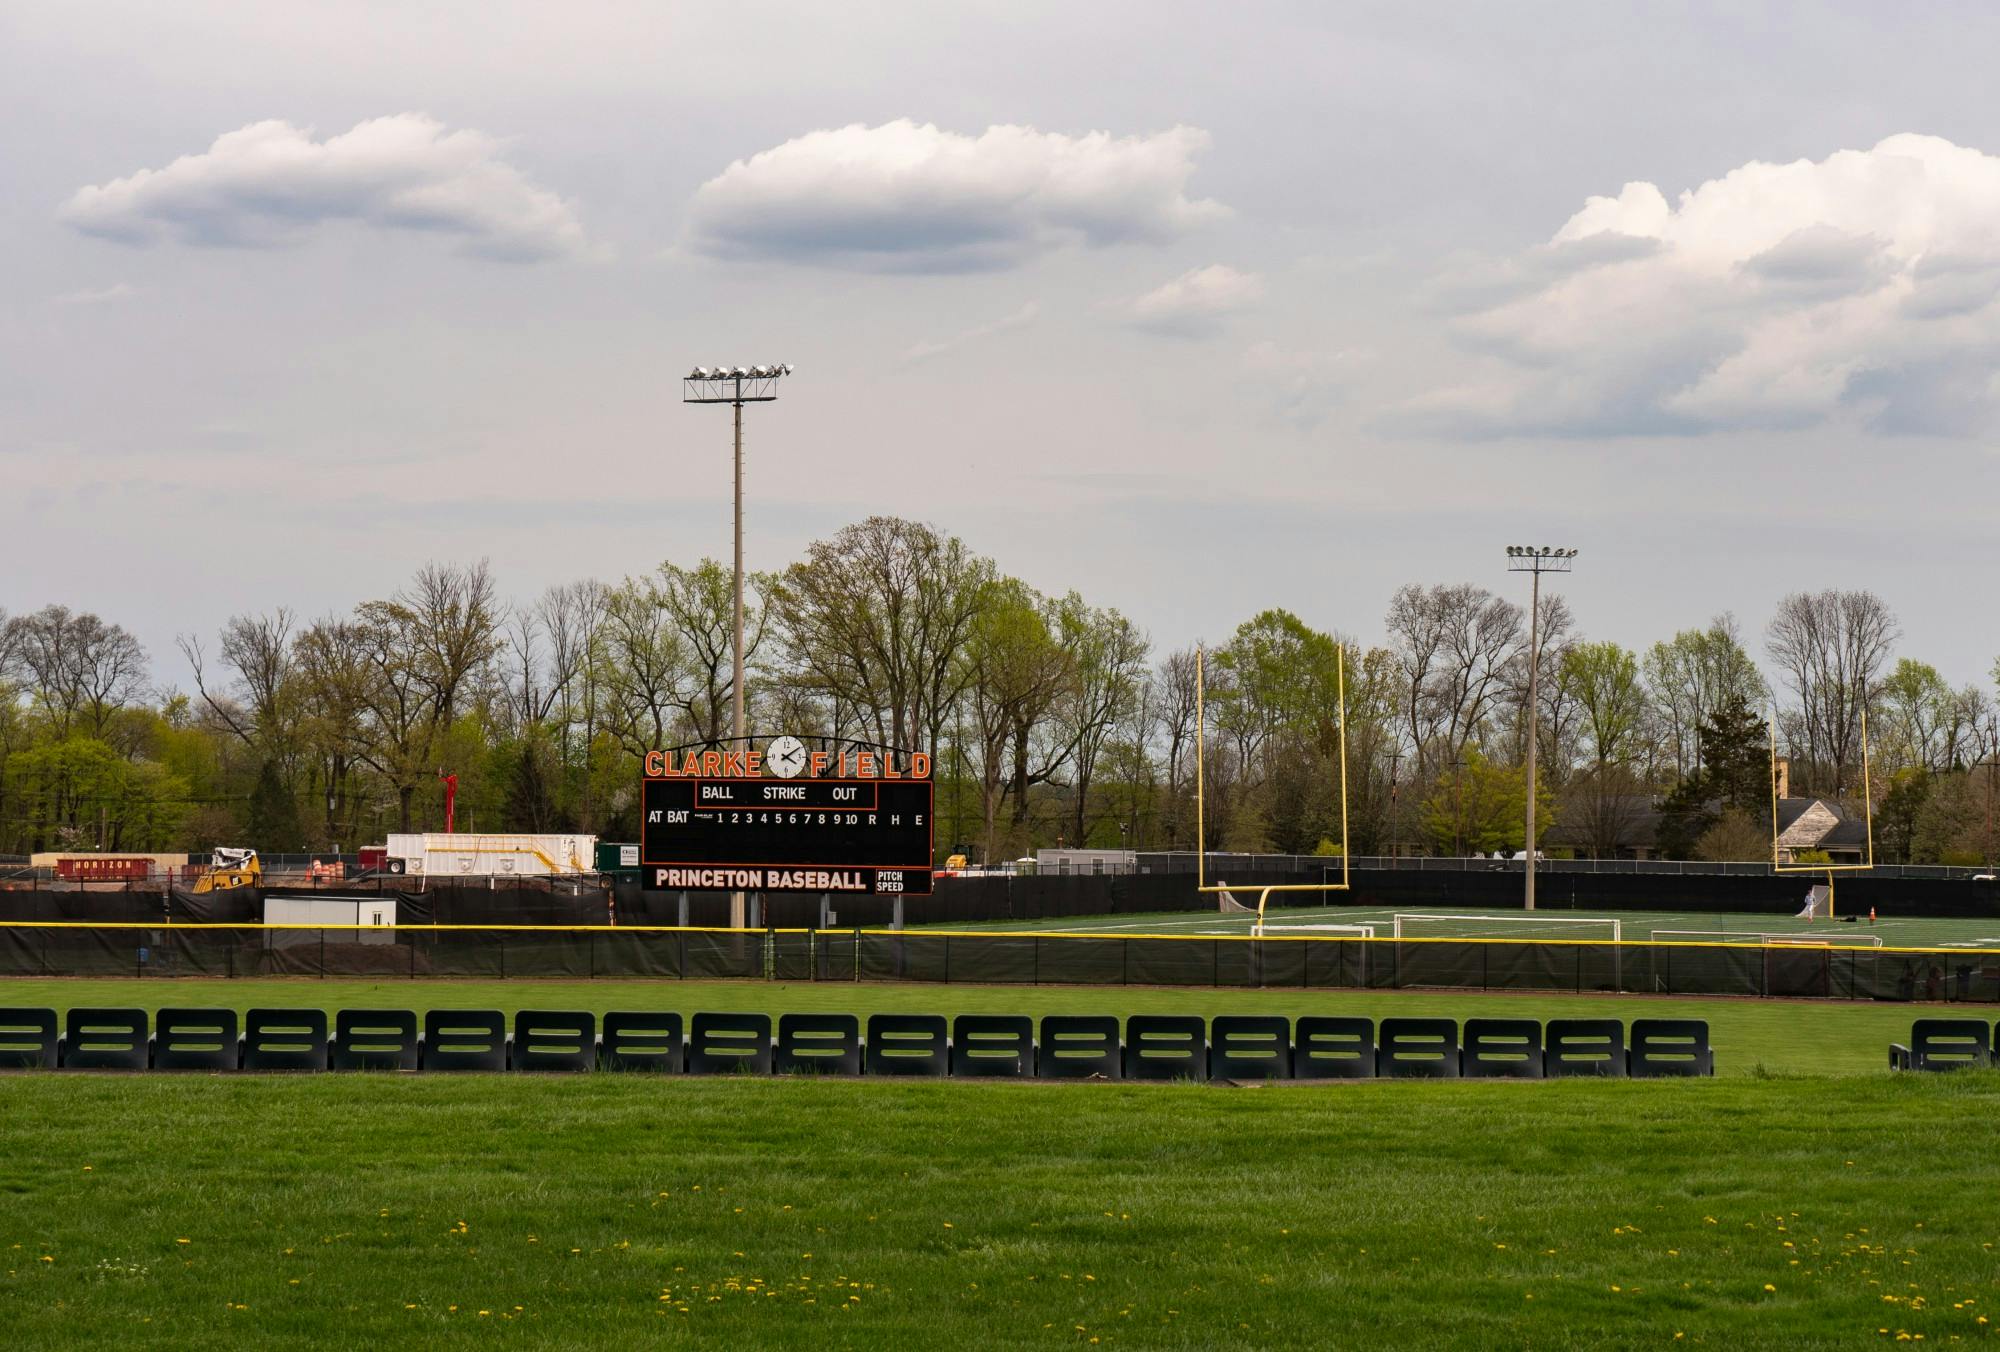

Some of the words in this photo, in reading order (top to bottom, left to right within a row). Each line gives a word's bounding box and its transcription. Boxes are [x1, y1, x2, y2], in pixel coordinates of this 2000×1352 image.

[783, 741, 791, 749] 12
[645, 750, 762, 777] CLARKE
[810, 751, 931, 778] FIELD
[702, 786, 734, 799] BALL
[763, 787, 806, 800] STRIKE
[832, 787, 857, 801] OUT
[648, 810, 663, 823] AT
[667, 810, 690, 823] BAT
[718, 813, 724, 823] 1
[731, 813, 739, 823] 2
[746, 813, 753, 823] 3
[760, 813, 768, 824] 4
[775, 814, 782, 824] 5
[789, 814, 797, 824] 6
[804, 814, 811, 824] 7
[818, 814, 826, 824] 8
[833, 815, 841, 825] 9
[845, 815, 858, 825] 10
[868, 815, 876, 825] R
[891, 815, 900, 825] H
[915, 815, 923, 825] E
[75, 861, 132, 869] HORIZON
[656, 869, 762, 888] PRINCETON
[767, 871, 867, 890] BASEBALL
[877, 871, 903, 882] PITCH
[876, 881, 904, 892] SPEED
